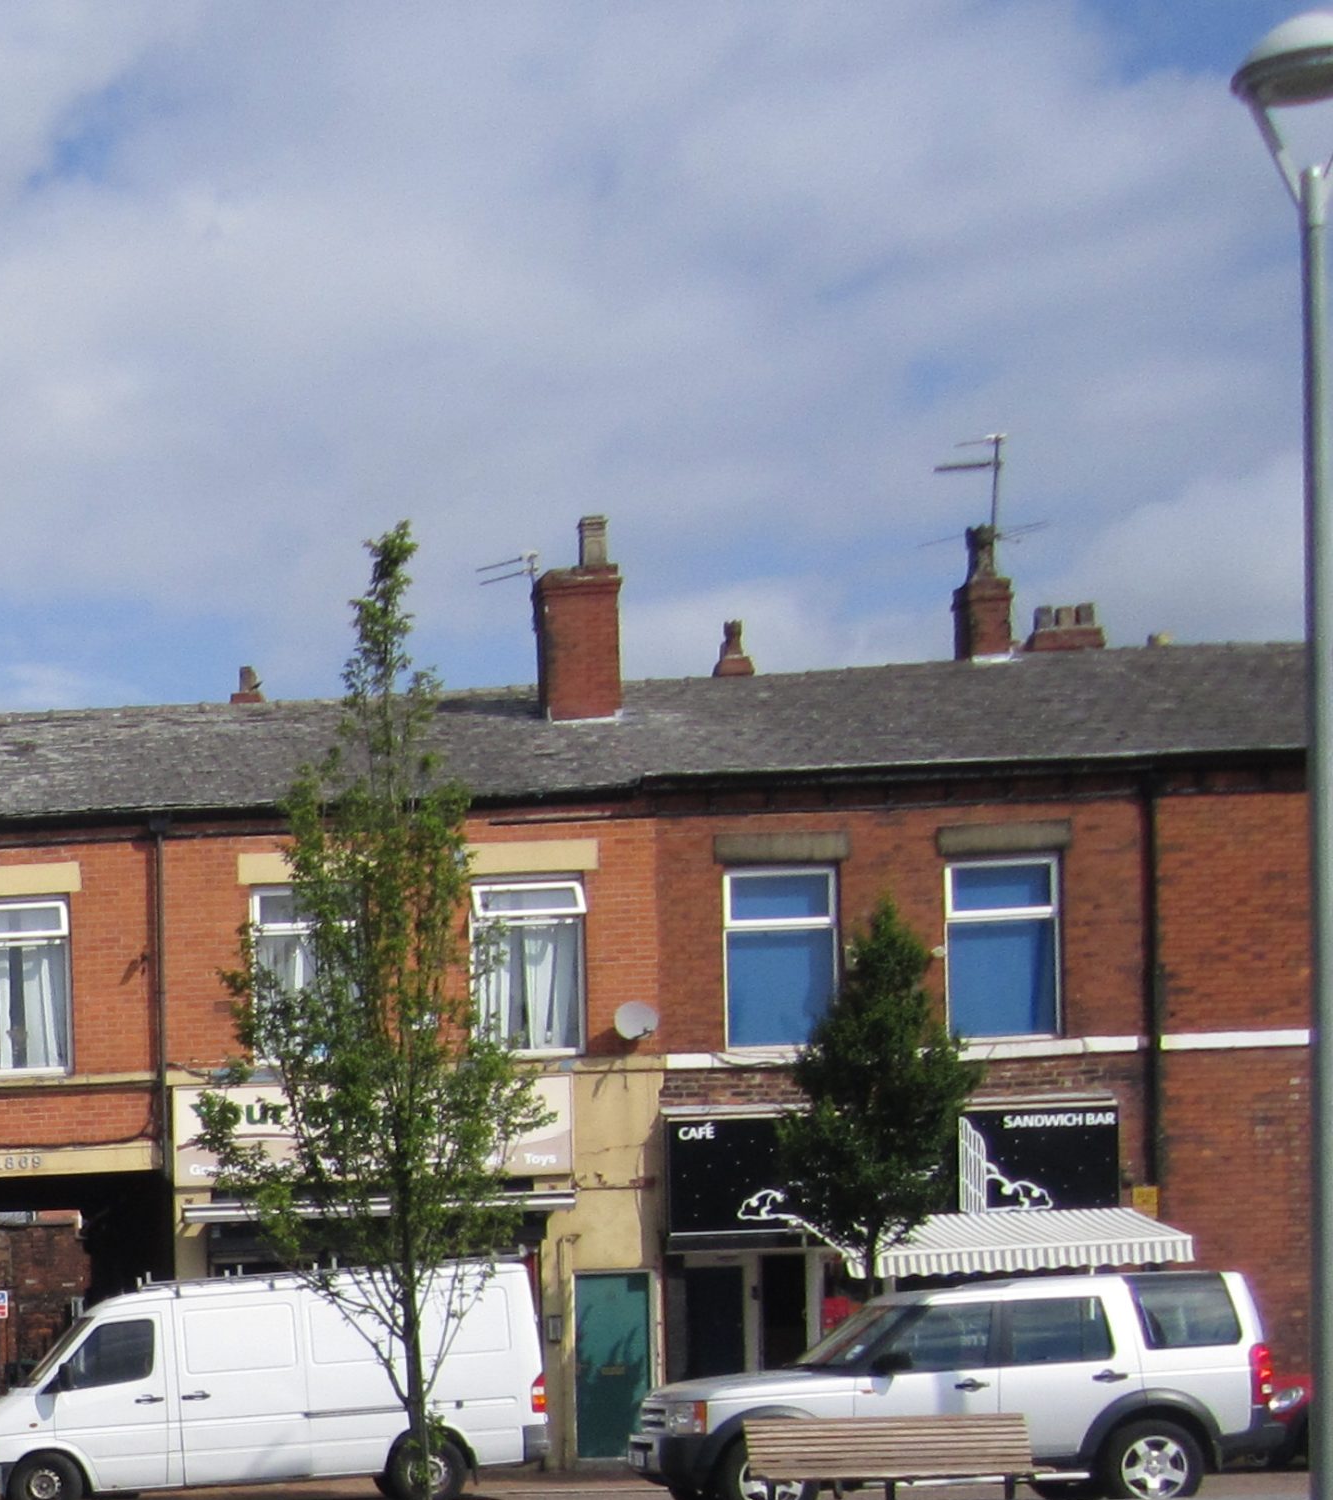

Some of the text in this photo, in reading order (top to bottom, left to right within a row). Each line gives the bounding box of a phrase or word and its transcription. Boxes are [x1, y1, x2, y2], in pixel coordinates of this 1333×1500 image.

[1003, 1112, 1116, 1129] SANDWICH BAR
[678, 1122, 716, 1140] CAFÉ
[523, 1152, 557, 1167] Toys
